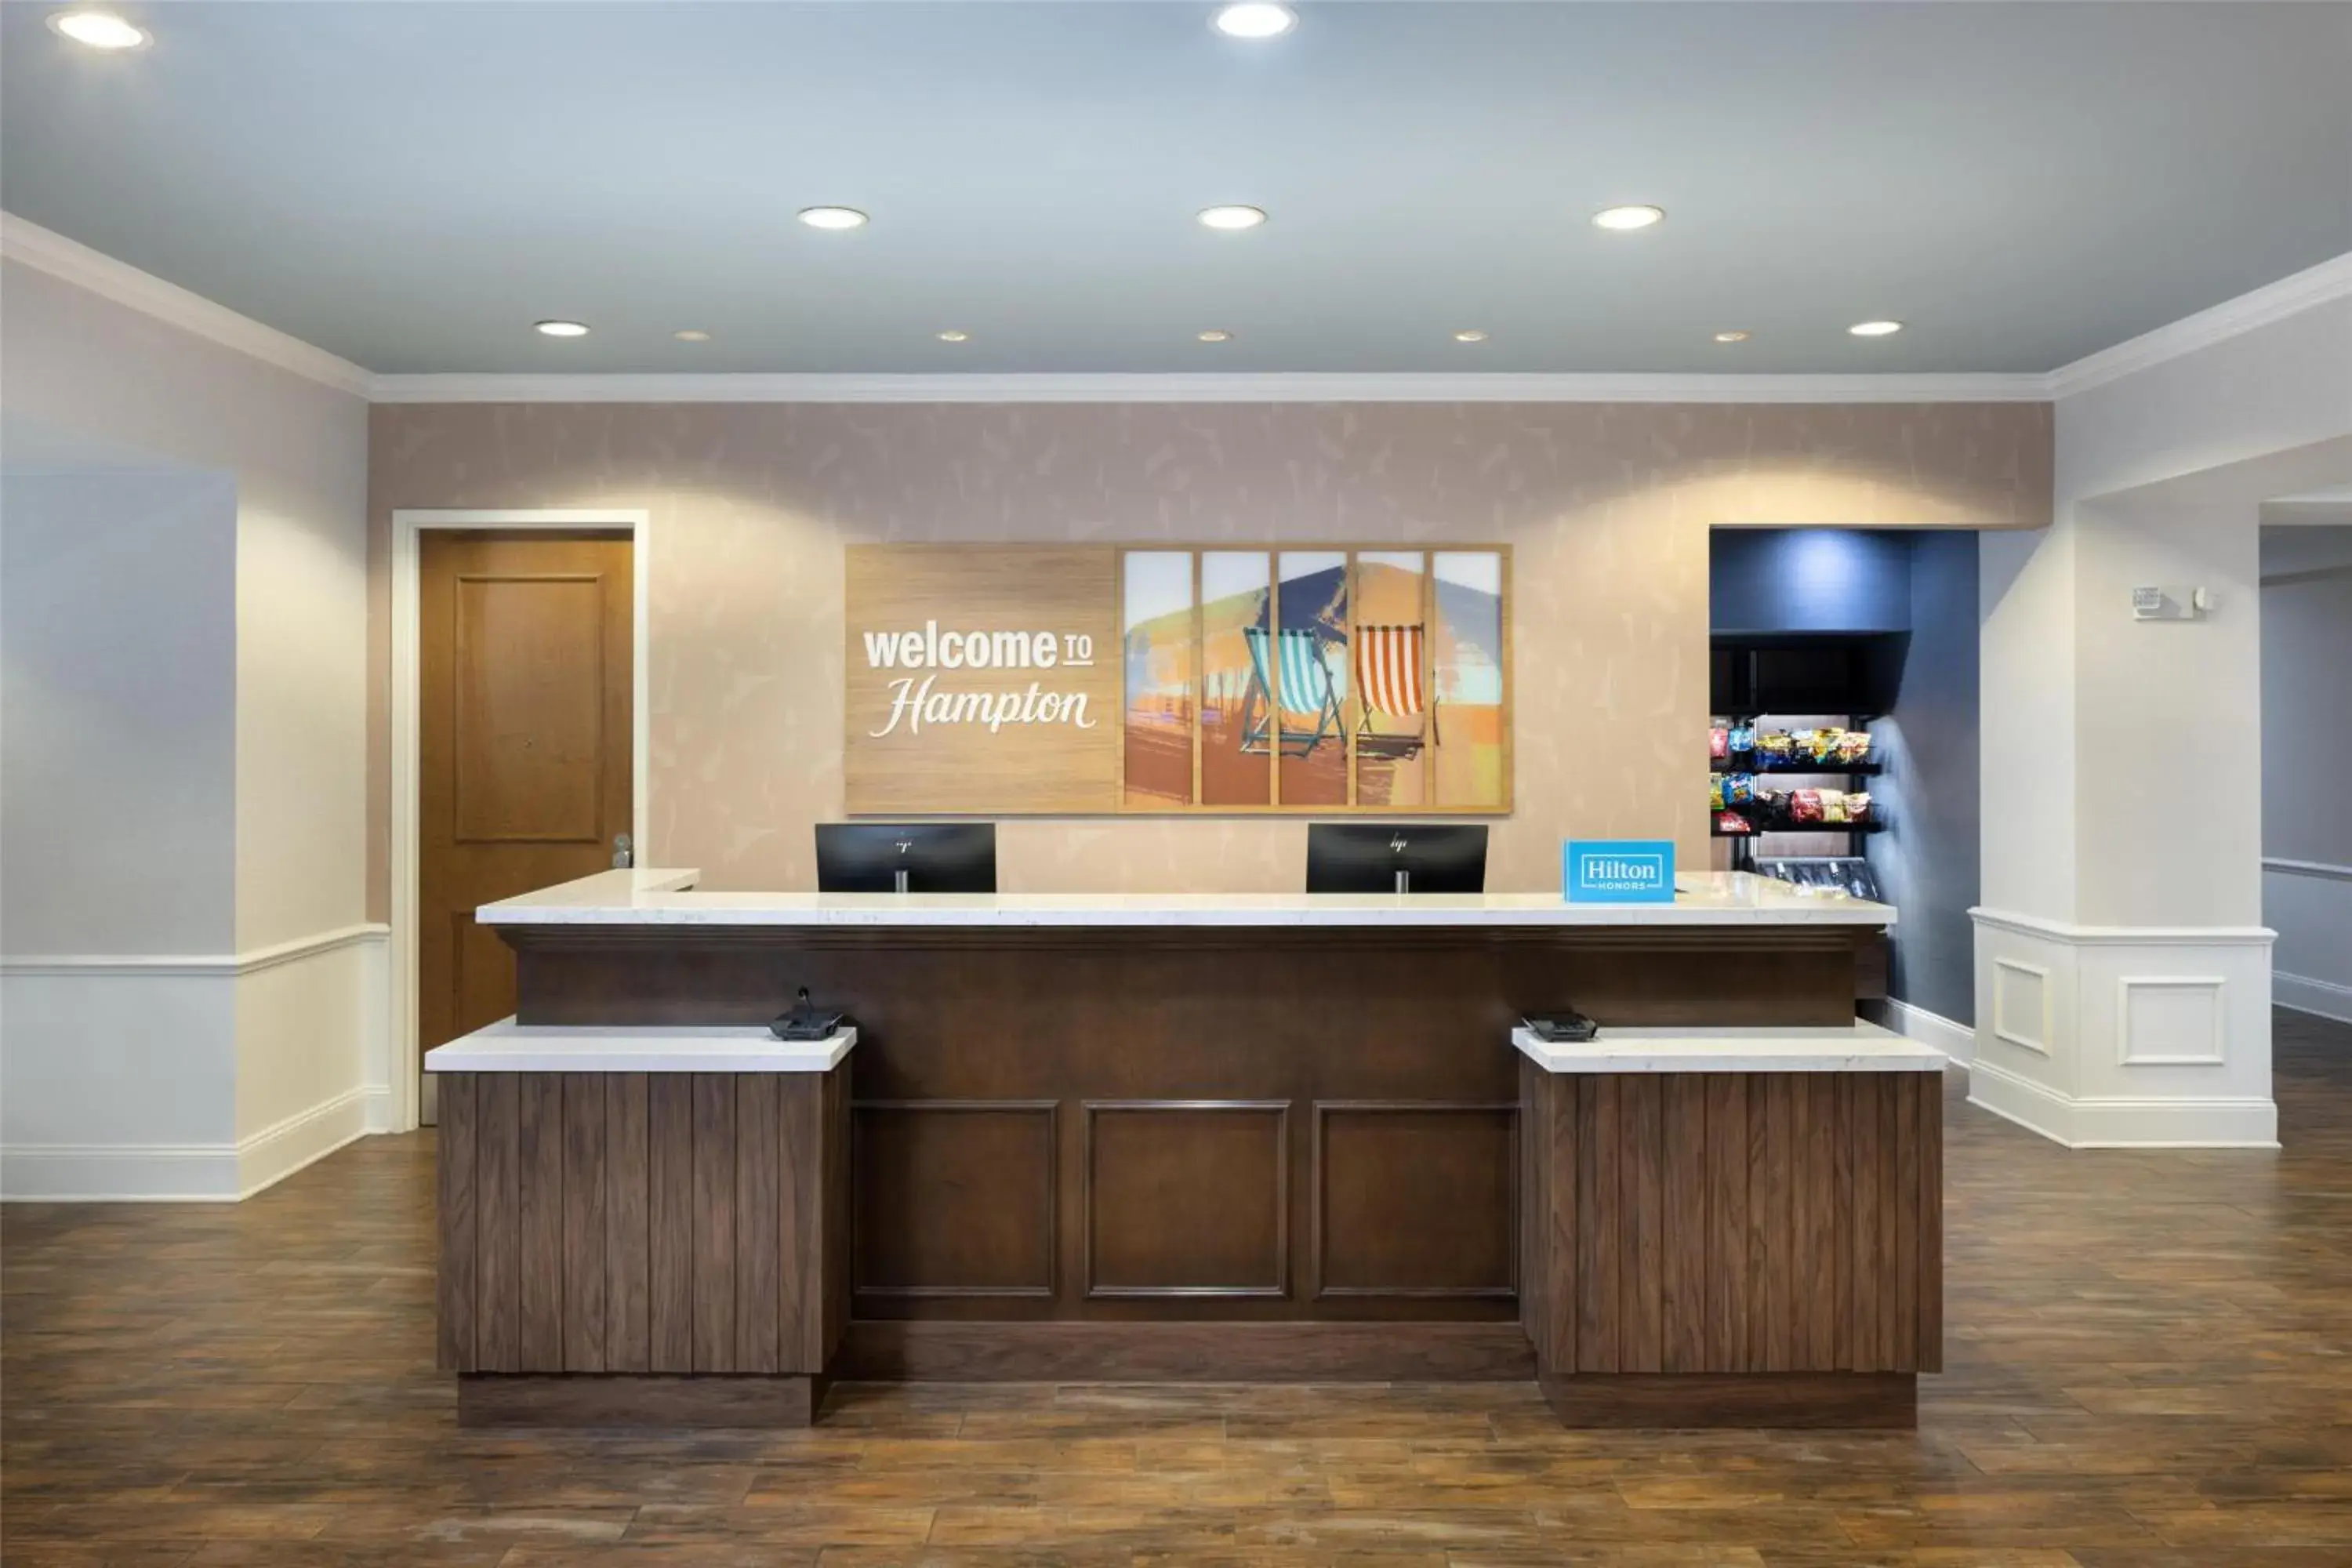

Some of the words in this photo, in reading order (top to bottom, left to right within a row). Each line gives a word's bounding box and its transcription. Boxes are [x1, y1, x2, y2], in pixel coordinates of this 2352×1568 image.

[863, 619, 1058, 668] welcome
[1063, 633, 1094, 665] TO
[869, 674, 1096, 738] Hampton
[1588, 859, 1656, 880] Hilton
[1598, 881, 1646, 891] HONORS
